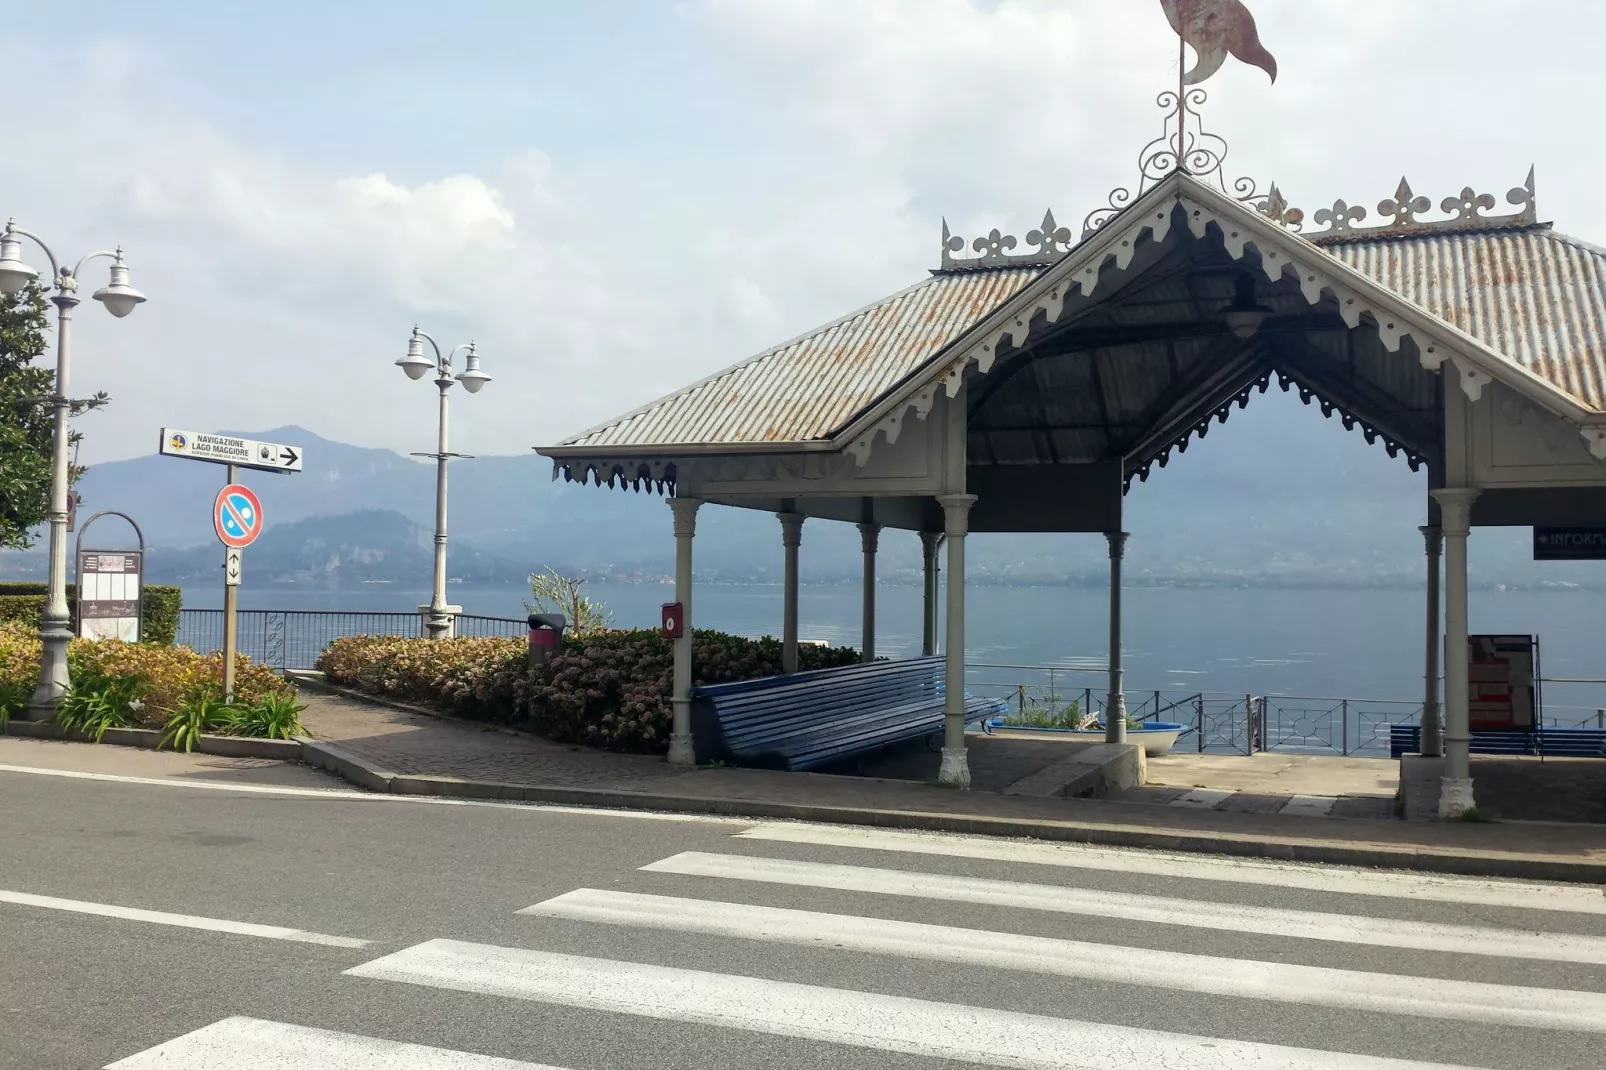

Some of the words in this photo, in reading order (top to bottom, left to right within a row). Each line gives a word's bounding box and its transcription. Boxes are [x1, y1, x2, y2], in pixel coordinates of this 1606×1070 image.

[197, 435, 244, 447] NAVIGAZIONE
[191, 443, 211, 451] LAGO
[212, 445, 249, 457] MAGGIORE
[1550, 533, 1606, 546] INFORM
